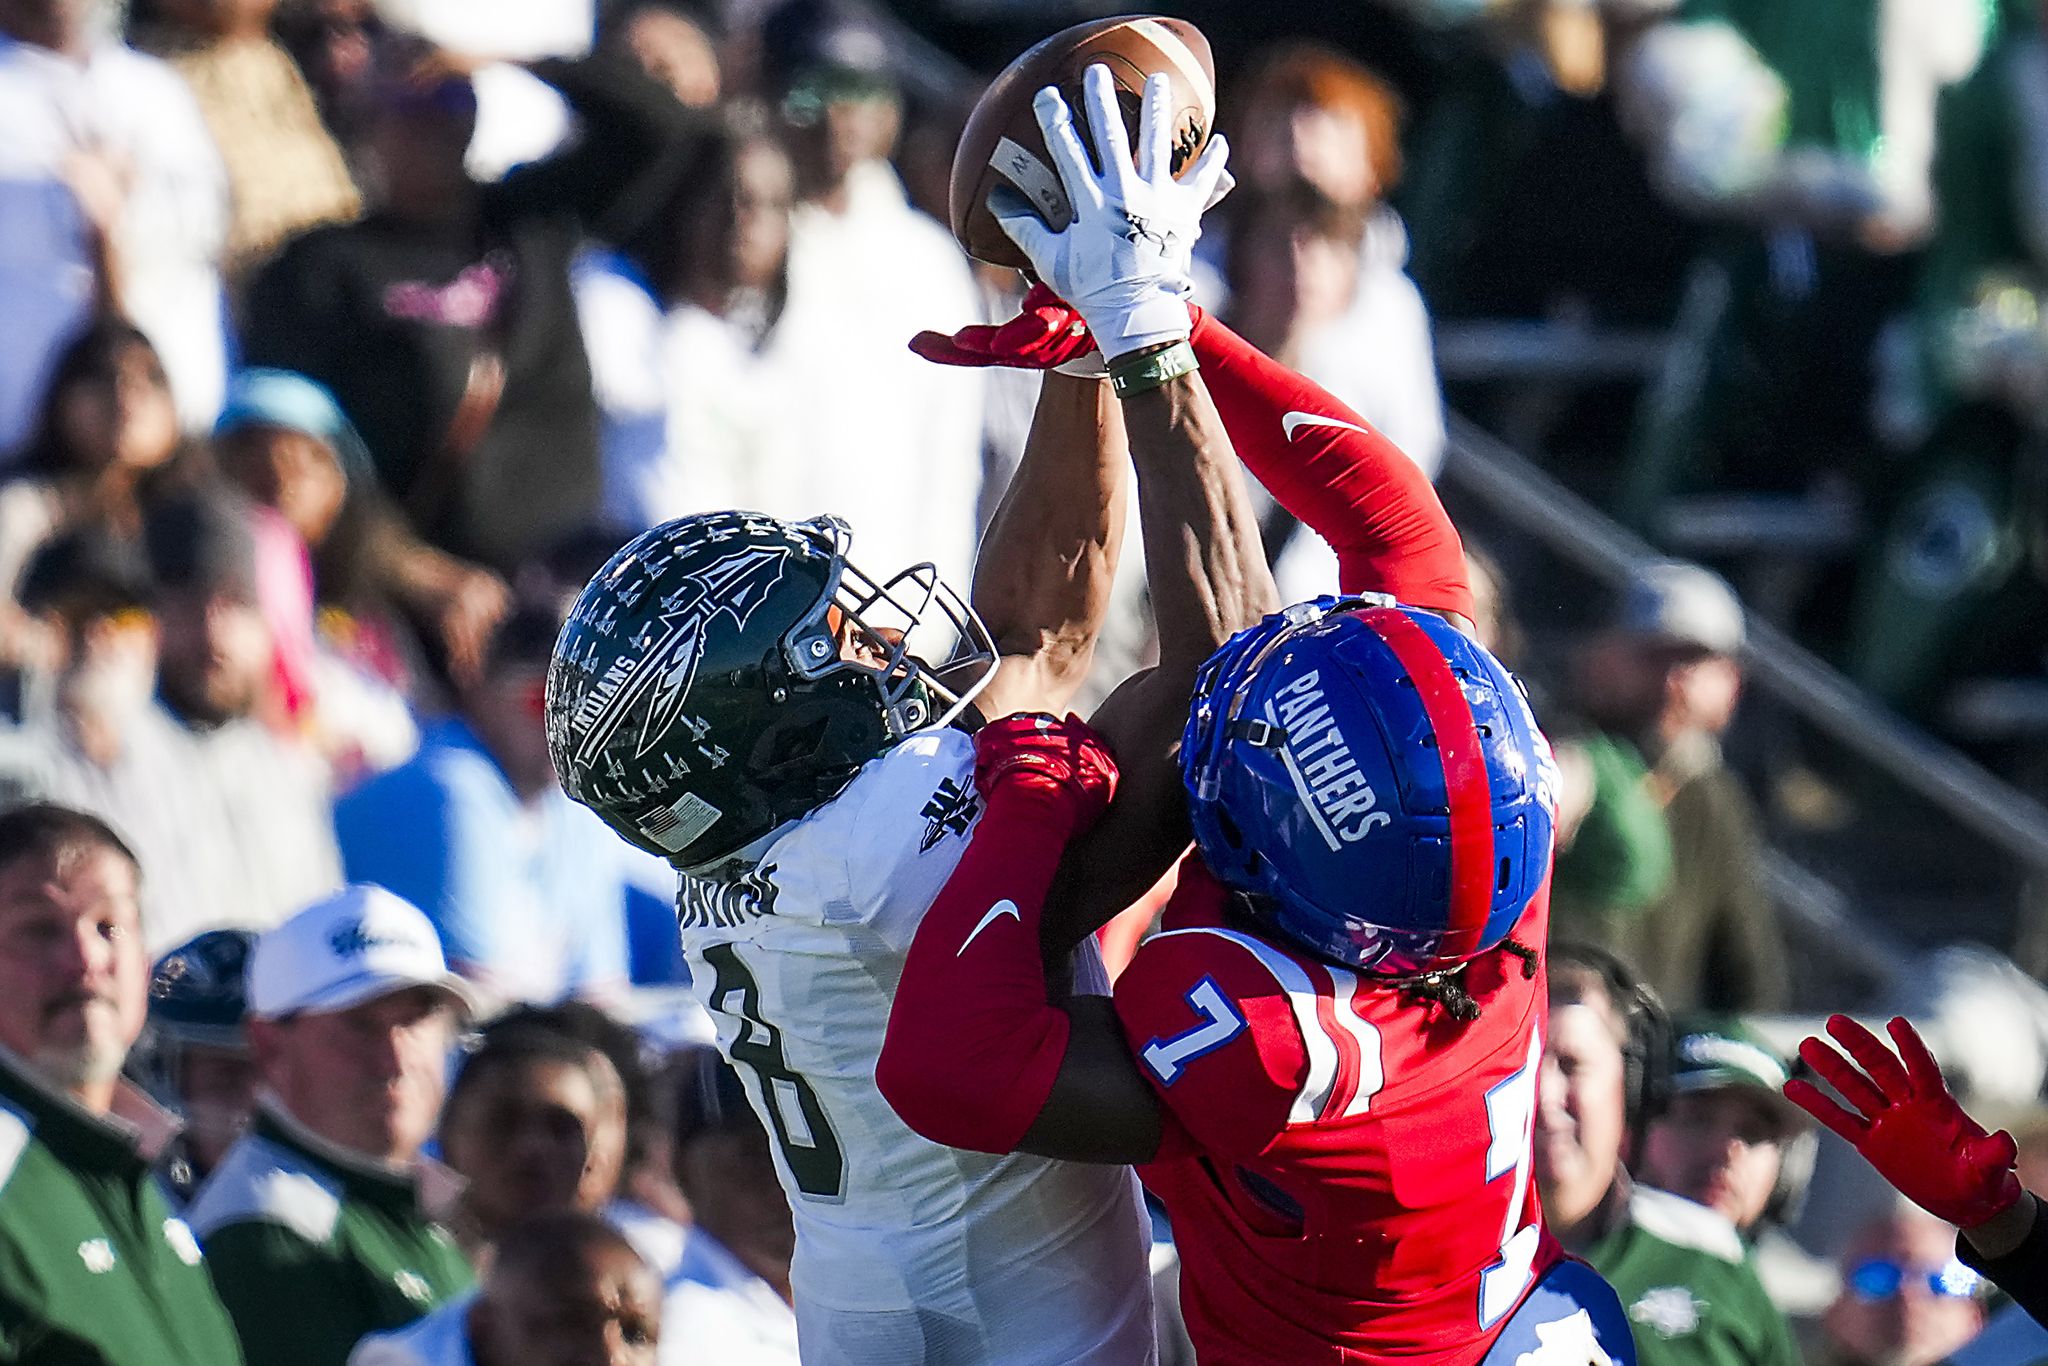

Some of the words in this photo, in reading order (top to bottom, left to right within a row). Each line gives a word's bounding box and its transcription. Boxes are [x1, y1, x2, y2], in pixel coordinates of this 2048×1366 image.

[571, 655, 637, 736] INDIANS
[1275, 669, 1391, 842] PANTHERS
[702, 942, 849, 1204] 8
[1140, 972, 1250, 1088] 7
